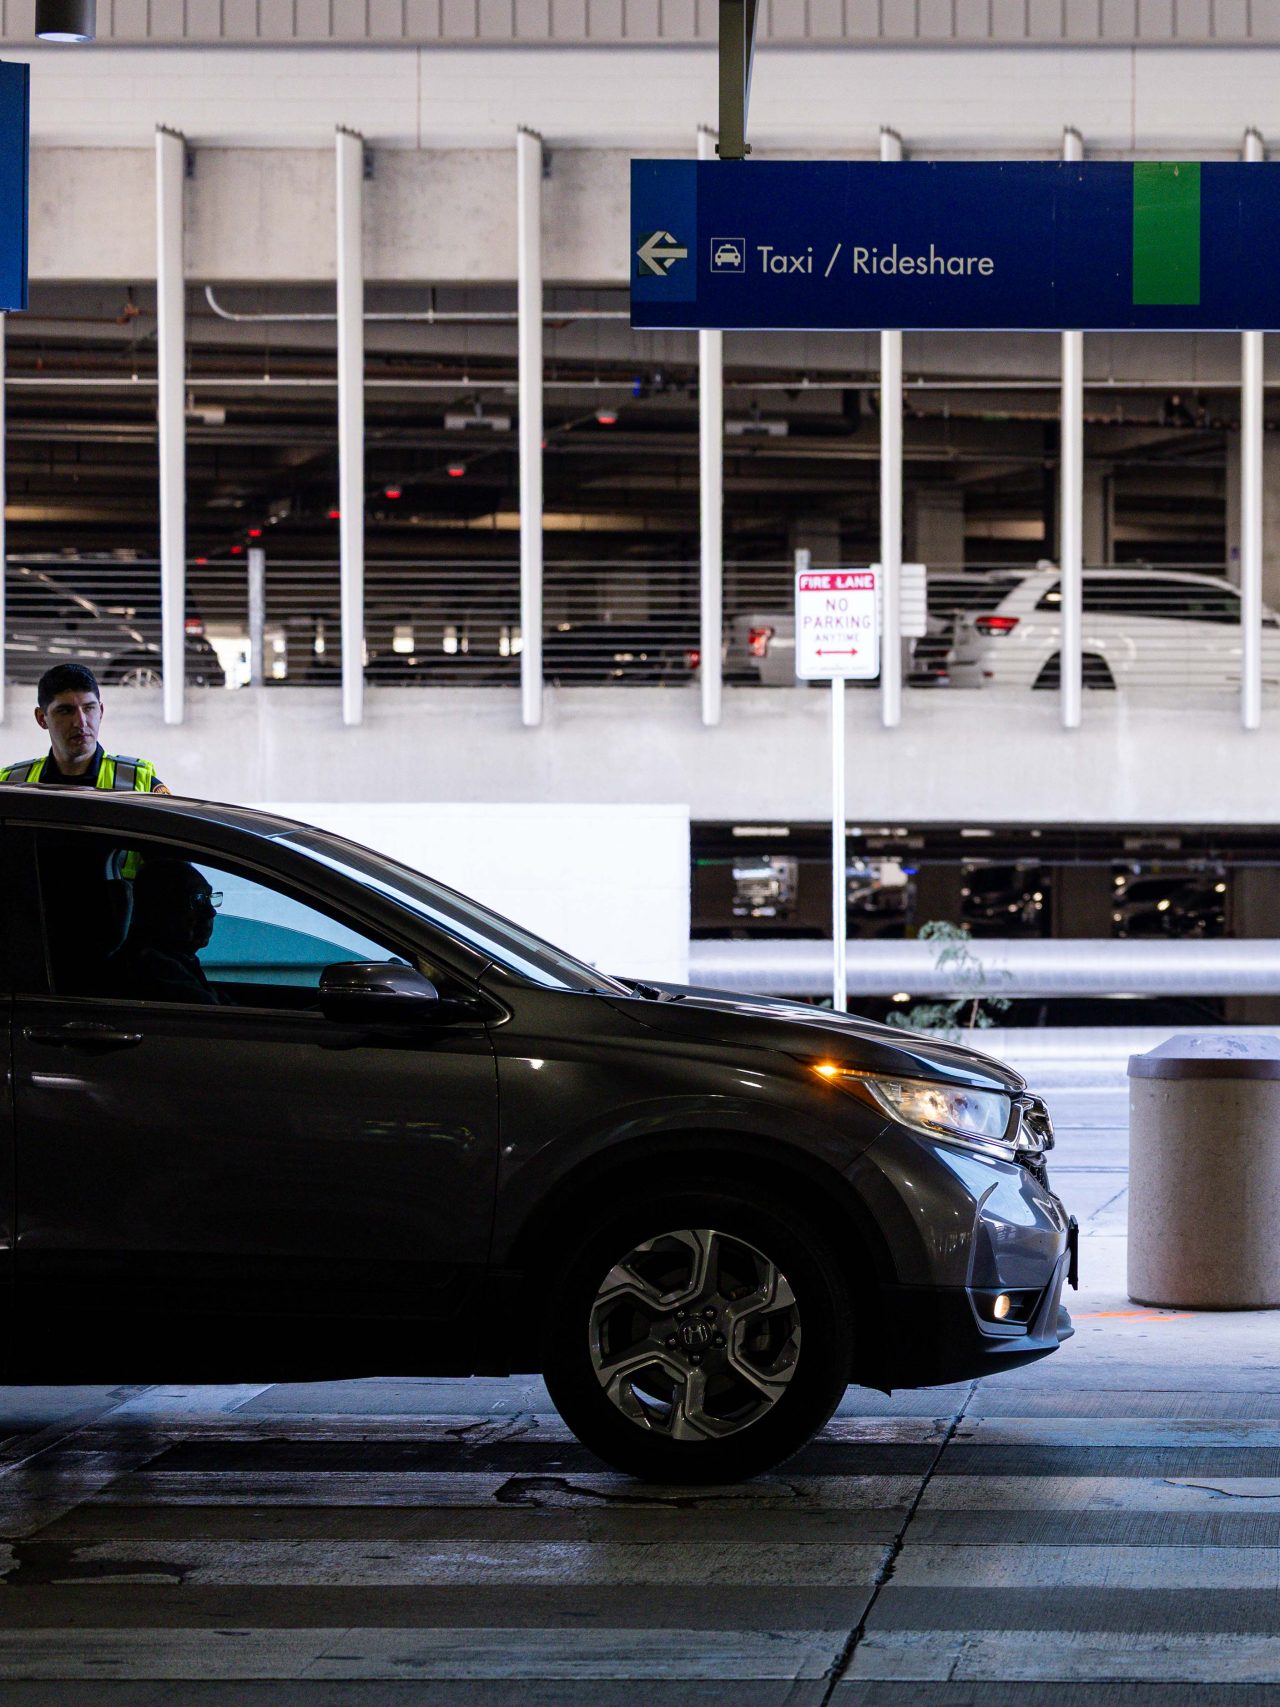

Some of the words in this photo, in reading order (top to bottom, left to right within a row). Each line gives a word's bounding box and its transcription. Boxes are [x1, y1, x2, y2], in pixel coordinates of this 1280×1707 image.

[757, 246, 814, 275] Taxi
[825, 243, 842, 277] /
[852, 243, 995, 276] Rideshare
[800, 575, 831, 589] FIRE
[836, 574, 873, 588] LANE
[826, 598, 848, 612] NO
[803, 615, 871, 629] PARKING
[815, 633, 859, 642] ANYTIME
